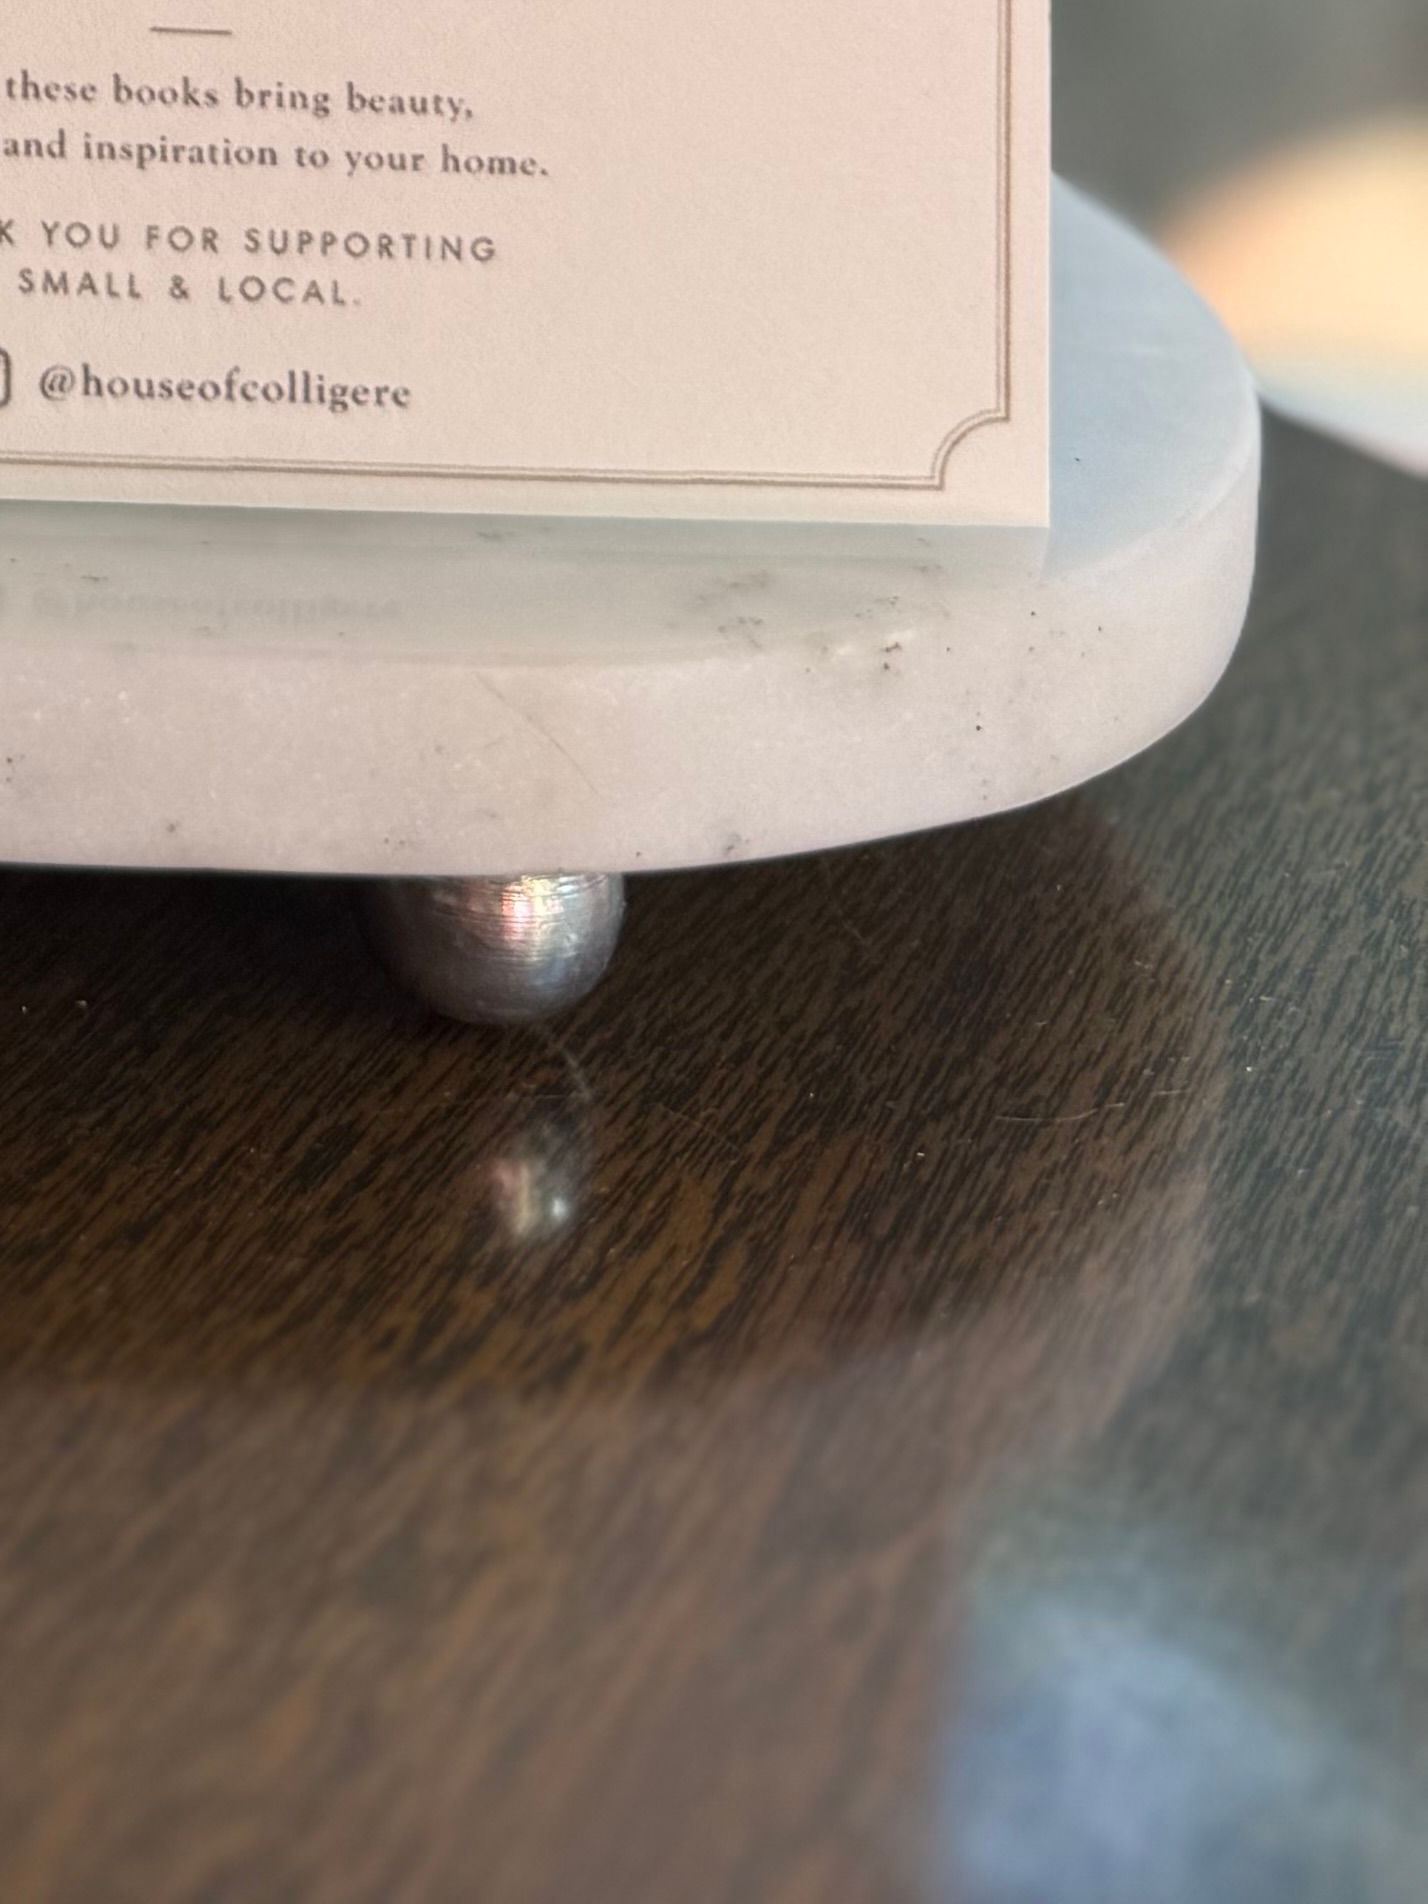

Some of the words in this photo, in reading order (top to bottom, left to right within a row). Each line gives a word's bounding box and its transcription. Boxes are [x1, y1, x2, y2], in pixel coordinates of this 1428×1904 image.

[5, 68, 98, 104] these
[112, 72, 220, 109] books
[233, 75, 331, 120] bring
[346, 80, 474, 124] beauty,
[2, 127, 67, 160] and
[83, 131, 279, 171] inspiration
[294, 146, 331, 170] to
[344, 150, 425, 178] your
[441, 142, 549, 177] home.
[40, 220, 121, 251] YOU
[145, 224, 219, 255] FOR
[244, 227, 496, 265] SUPPORTING
[17, 267, 143, 301] SMALL
[167, 274, 191, 302] &
[217, 275, 360, 307] LOCAL.
[38, 361, 411, 415] @houseofcolligere
